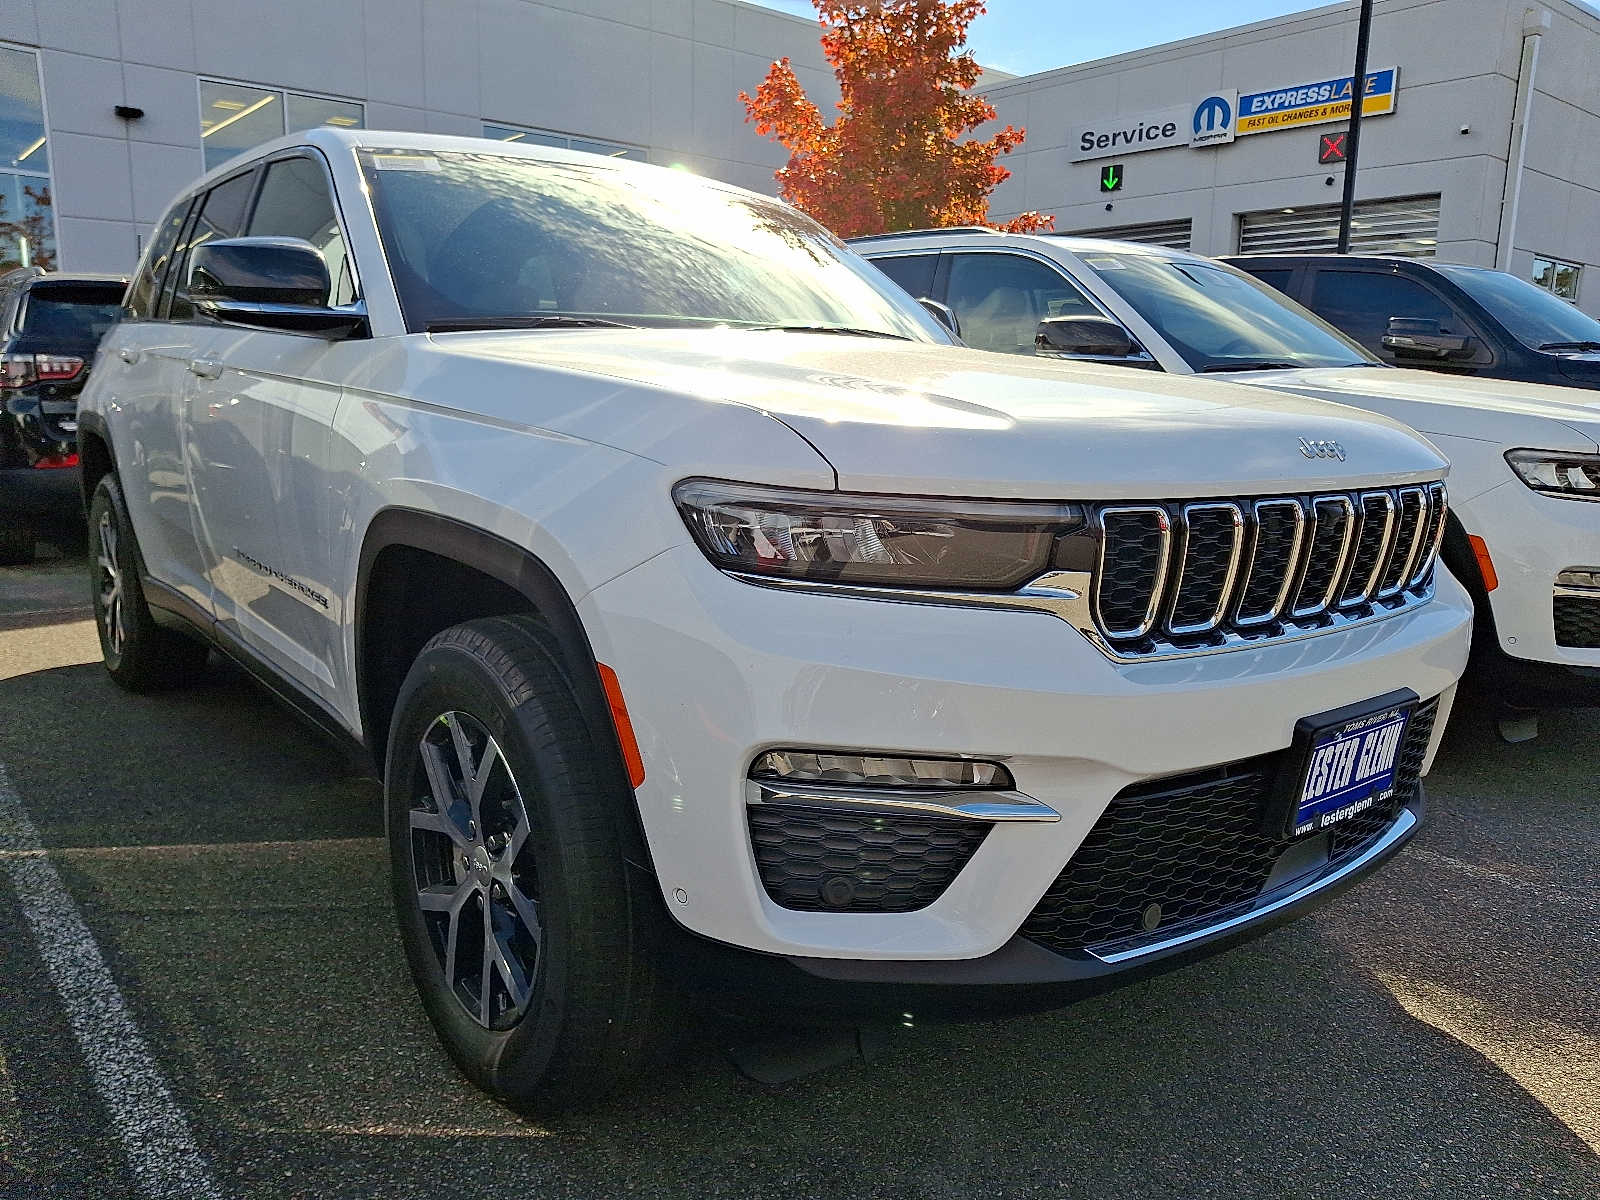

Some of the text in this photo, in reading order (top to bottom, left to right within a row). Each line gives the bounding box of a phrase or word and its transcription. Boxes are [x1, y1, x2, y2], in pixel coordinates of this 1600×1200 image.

[1247, 103, 1353, 128] FAST OIL CHANGES & MOR
[1080, 122, 1177, 151] Service
[1298, 436, 1346, 462] Jeep
[1343, 719, 1367, 733] TOMS
[1366, 712, 1388, 727] RIVER
[1300, 721, 1404, 803] LESTER GLENN
[1295, 821, 1314, 836] www.
[1320, 796, 1373, 828] lesterglenn
